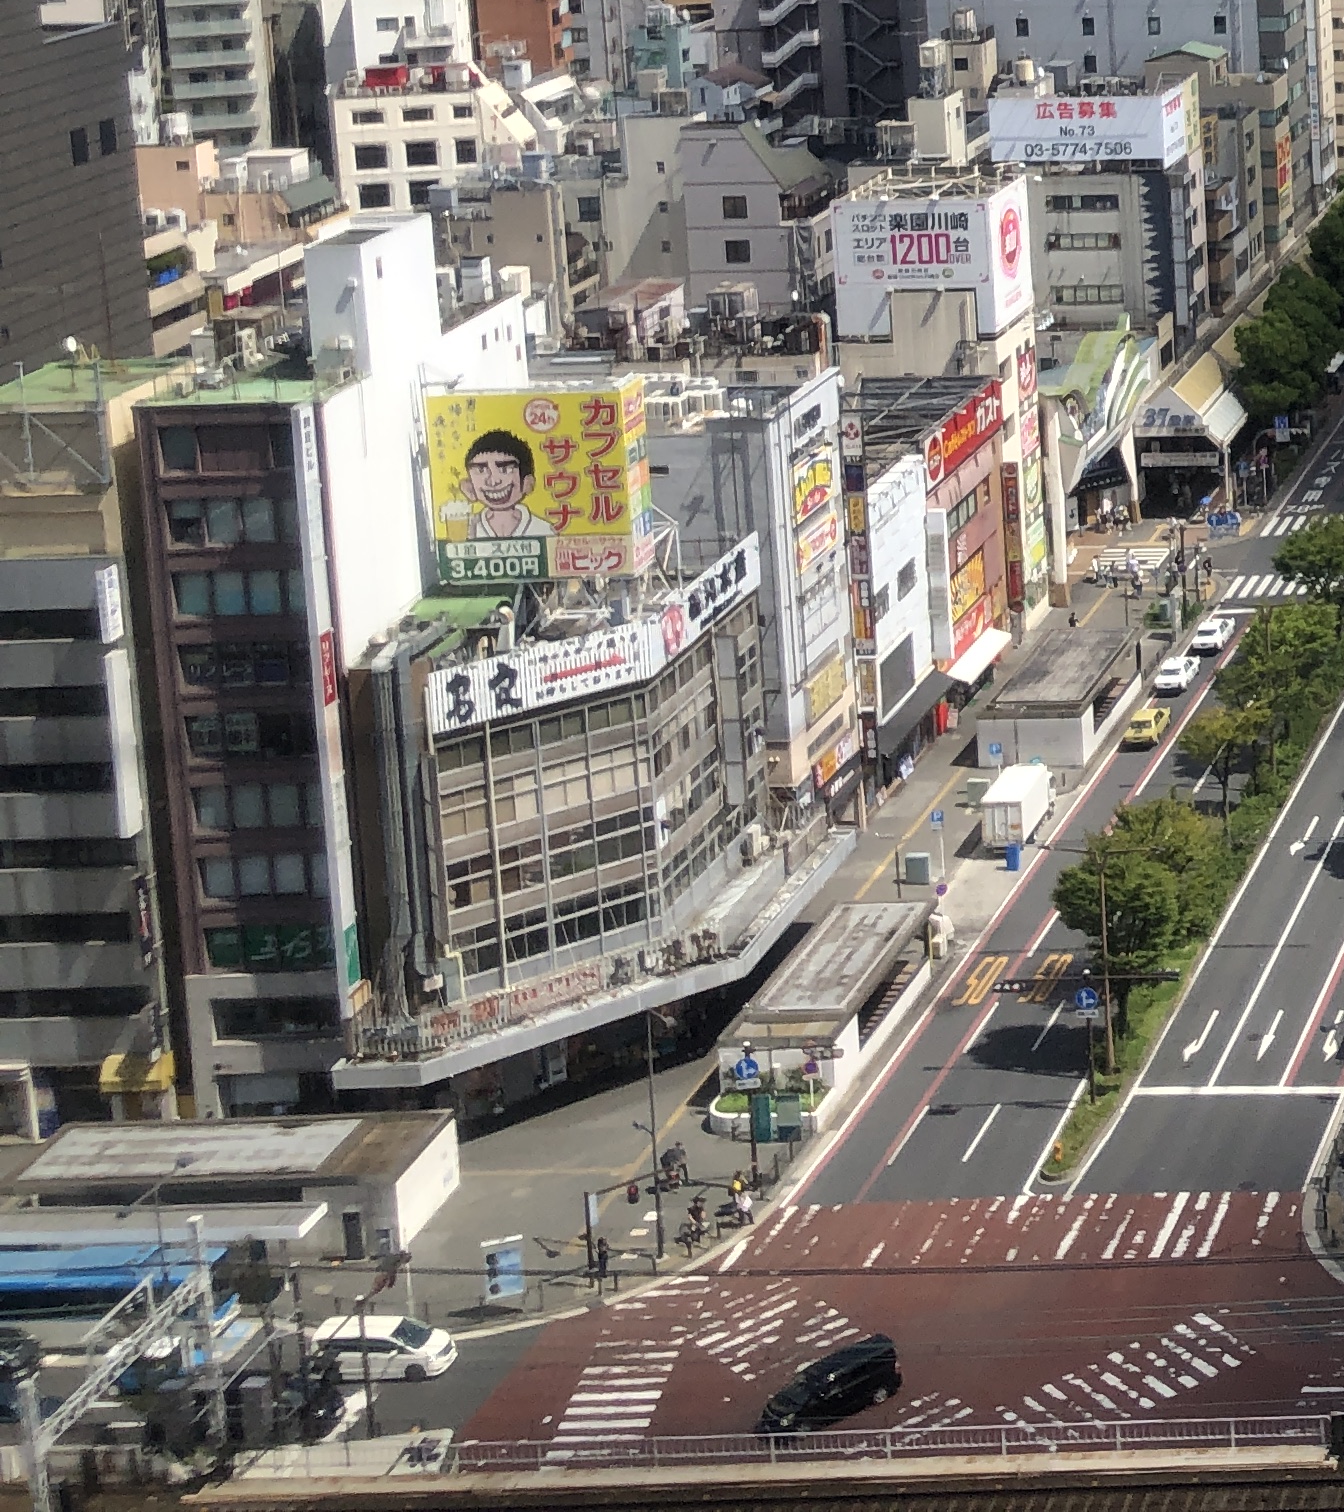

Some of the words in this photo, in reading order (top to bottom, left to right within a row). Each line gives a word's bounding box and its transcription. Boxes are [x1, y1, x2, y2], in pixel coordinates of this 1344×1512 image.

[1036, 102, 1117, 120] 広告募集
[1059, 125, 1095, 137] No.73
[1024, 141, 1132, 158] 03-5774-7506
[851, 214, 887, 223] パチンコ
[889, 212, 969, 231] 楽園川崎
[852, 224, 887, 233] スロット
[853, 237, 887, 250] エリア
[889, 233, 951, 265] 1200
[953, 237, 970, 253] 台
[950, 253, 972, 265] OVER
[976, 395, 1001, 435] ガスト
[541, 436, 582, 534] サウナ
[450, 556, 540, 579] 3,400円
[950, 956, 1009, 1006] 50
